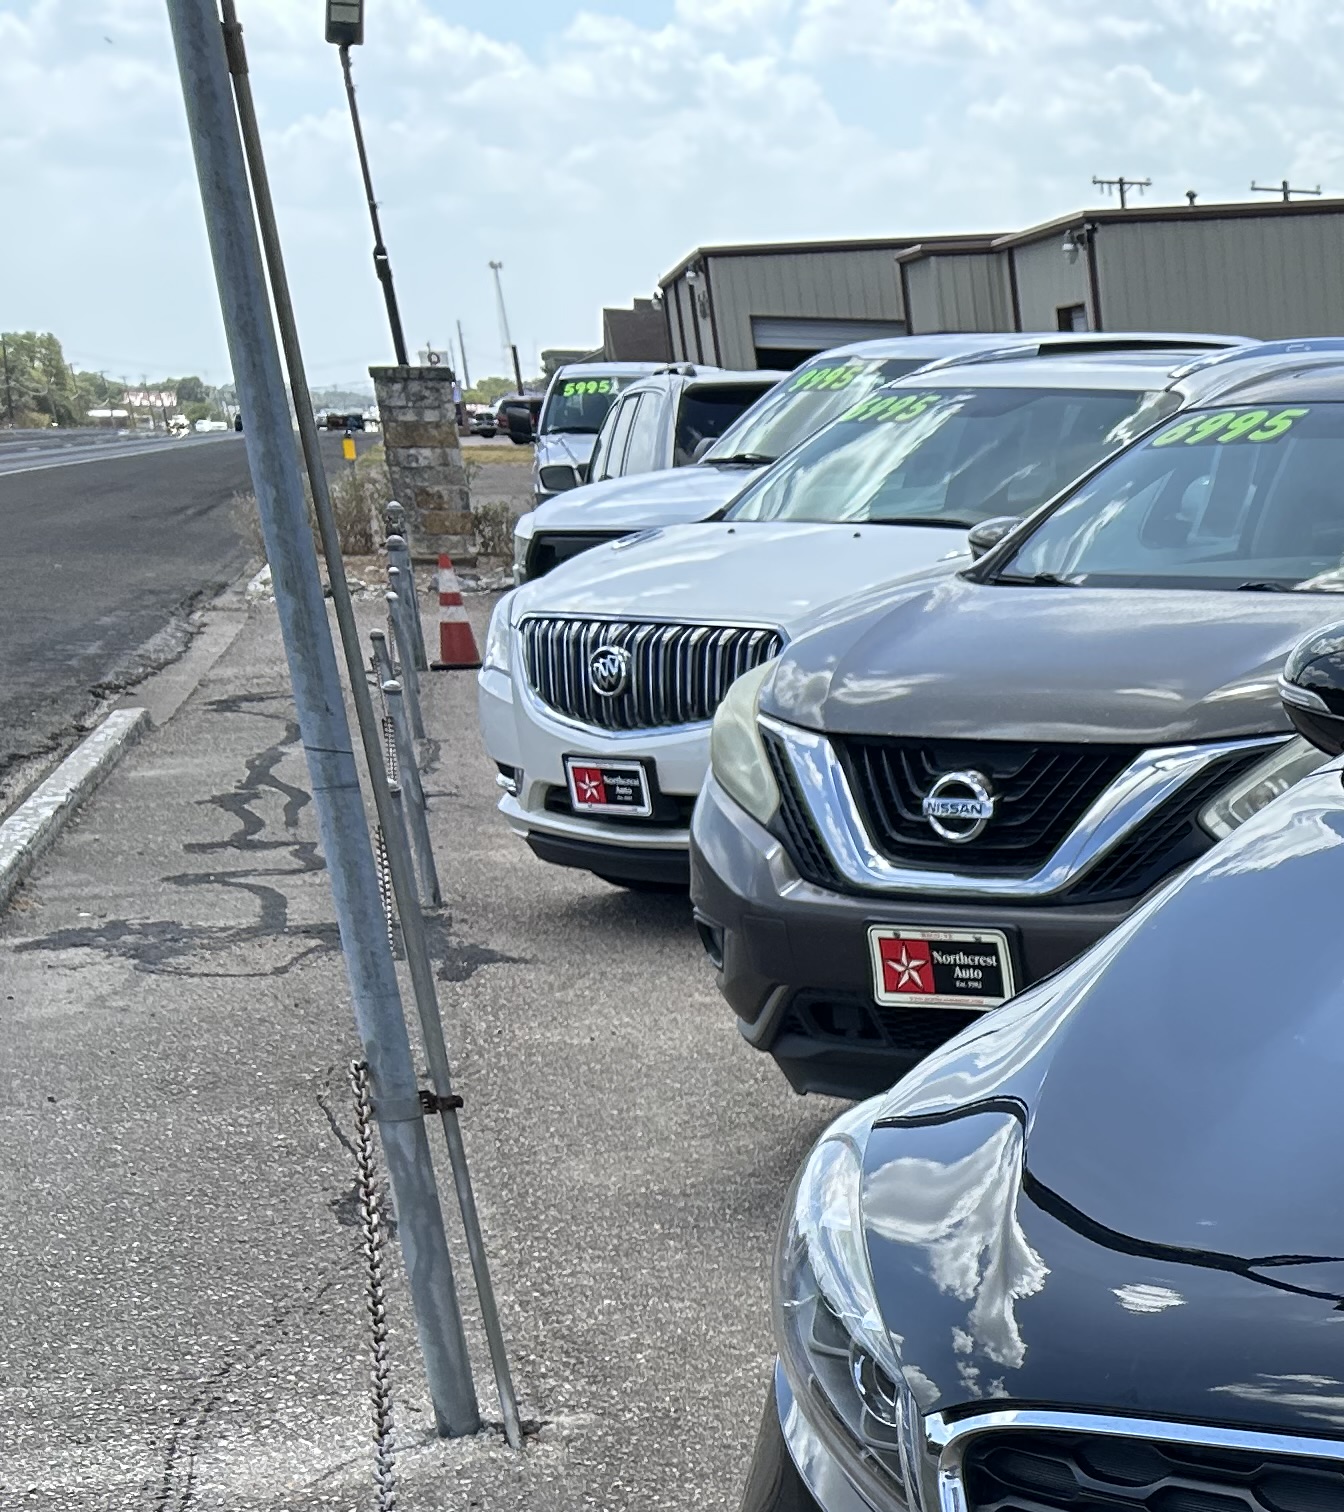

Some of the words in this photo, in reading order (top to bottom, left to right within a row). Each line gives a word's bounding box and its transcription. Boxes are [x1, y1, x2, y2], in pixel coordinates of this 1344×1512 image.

[563, 380, 610, 397] 5995
[1152, 408, 1310, 447] 6995
[927, 802, 983, 816] NISSAN
[932, 951, 998, 967] Northcrest
[953, 966, 983, 980] Auto
